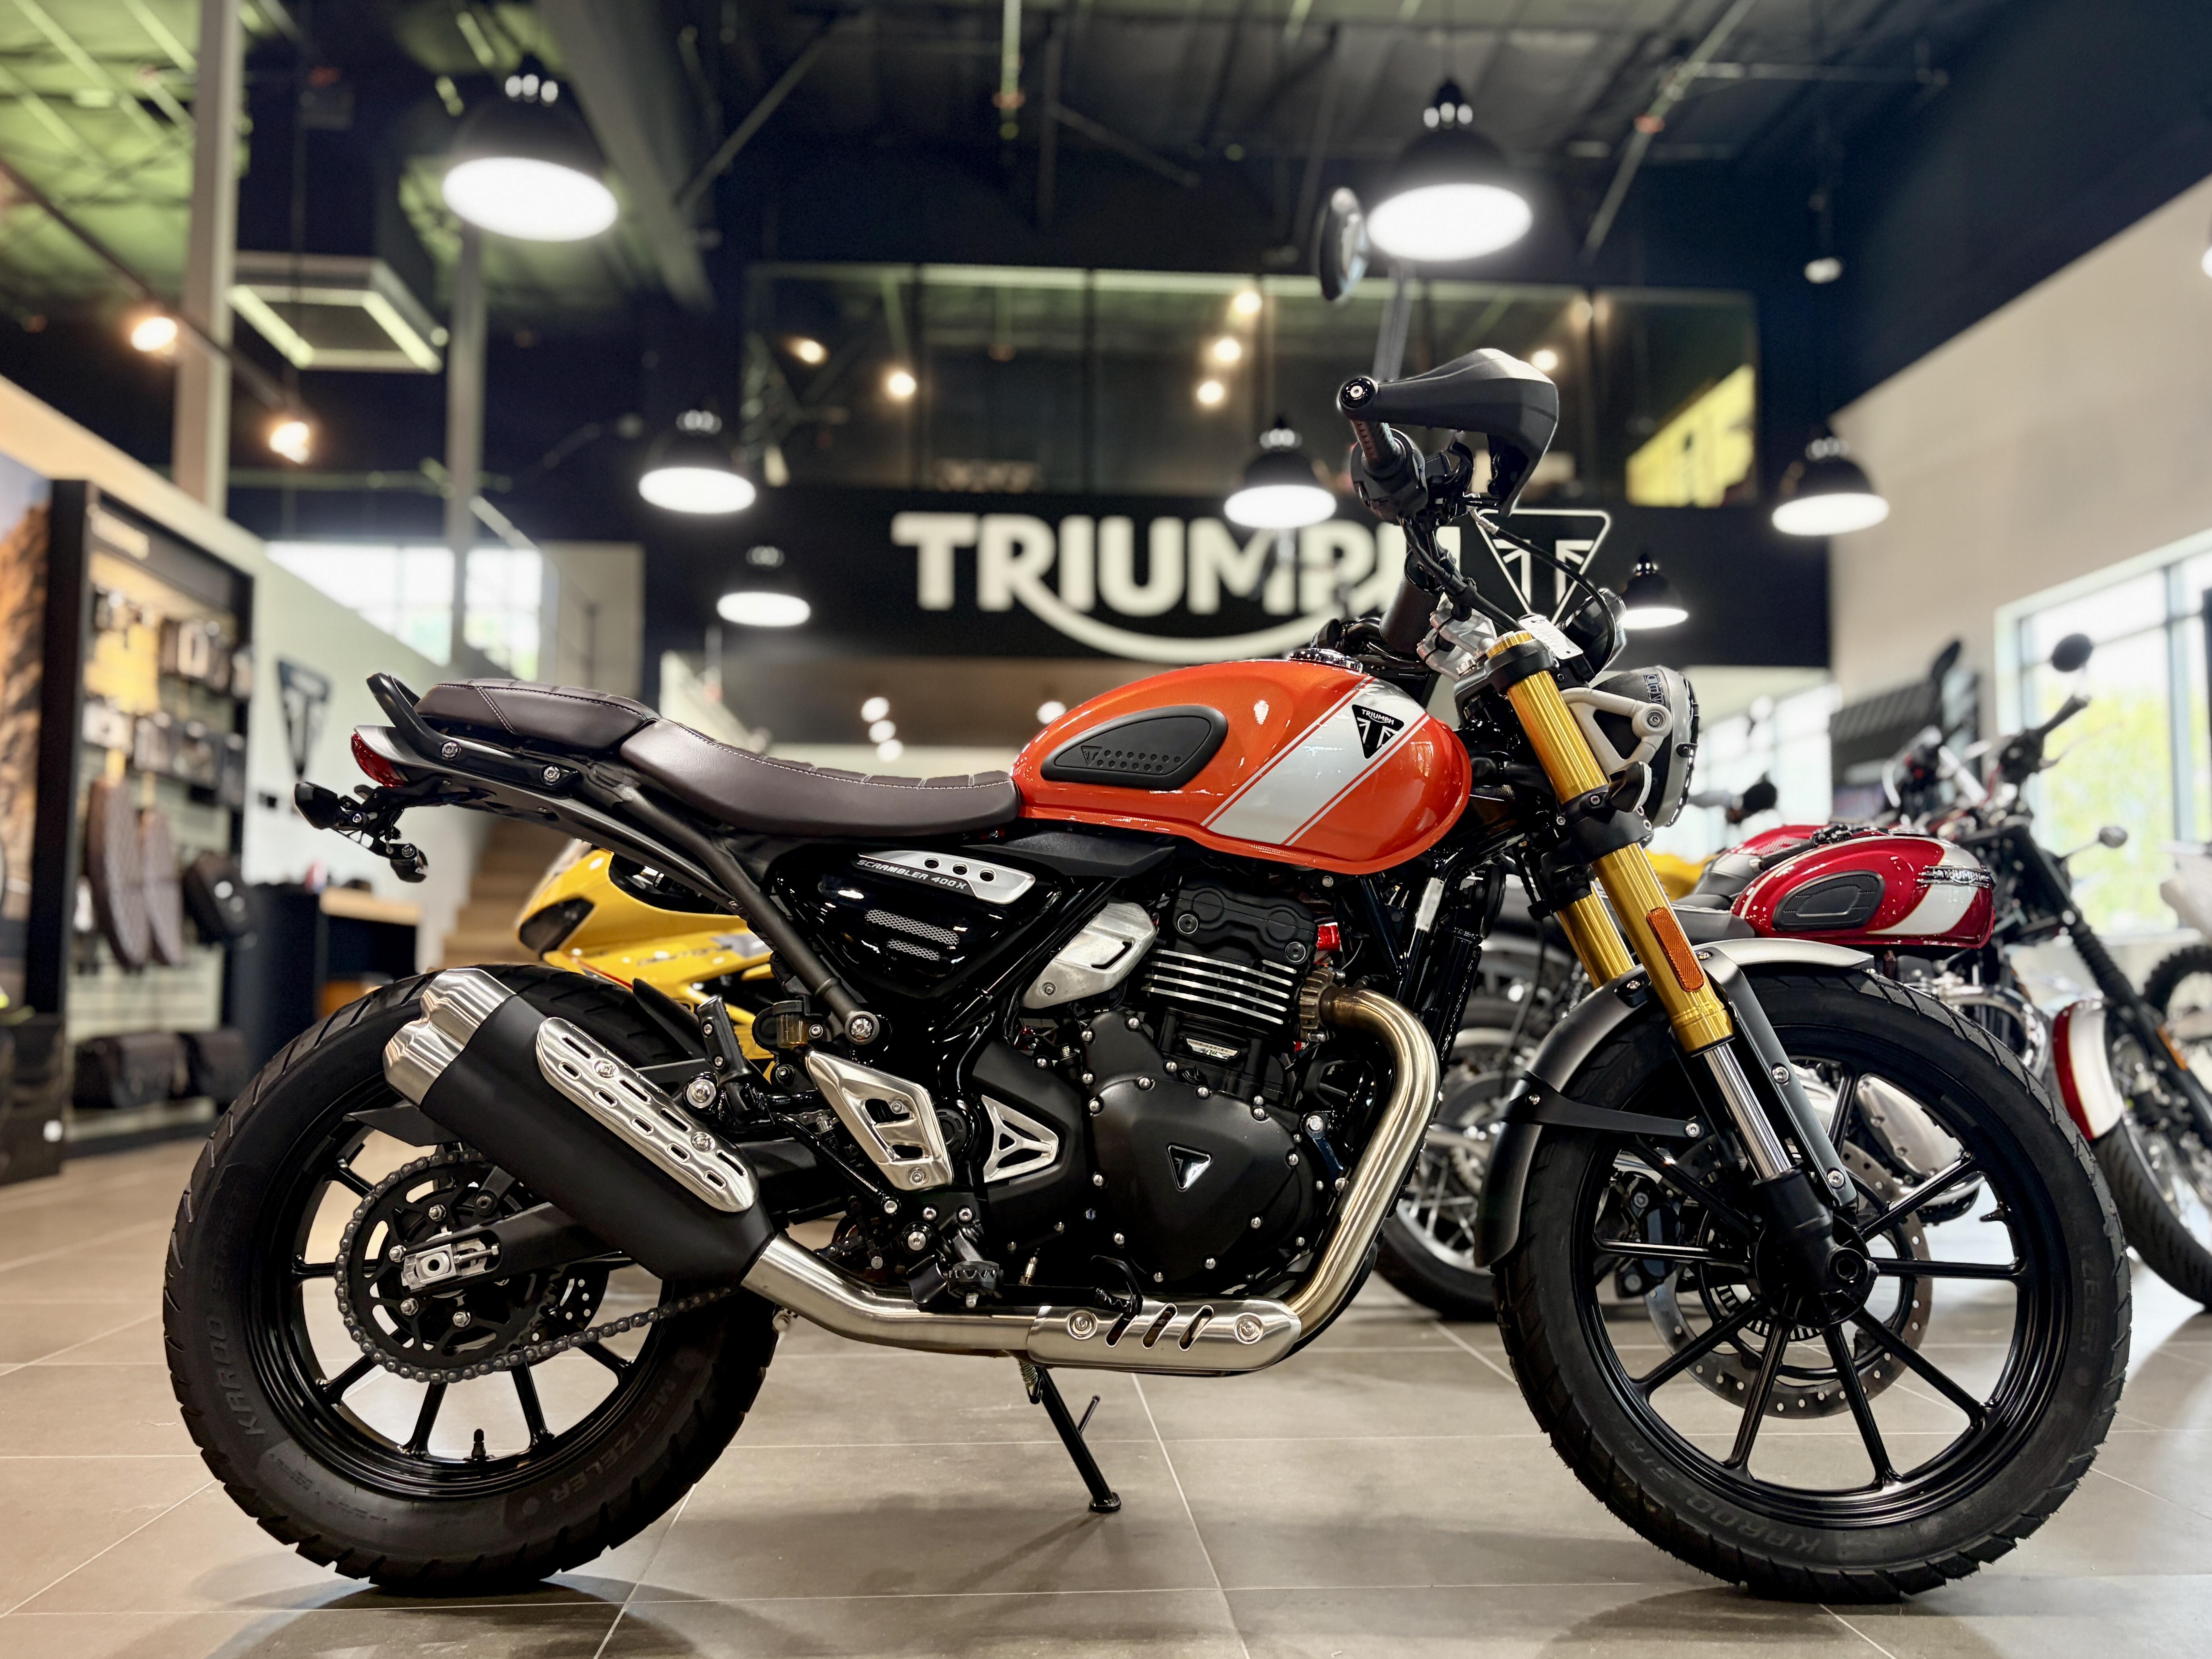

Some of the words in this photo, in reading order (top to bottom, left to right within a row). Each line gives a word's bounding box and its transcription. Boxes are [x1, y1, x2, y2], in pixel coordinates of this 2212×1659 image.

[1362, 709, 1394, 725] TRIUMPH
[856, 859, 929, 880] SCRAMBLER
[931, 877, 957, 887] 400
[1687, 1495, 1821, 1555] KAROO
